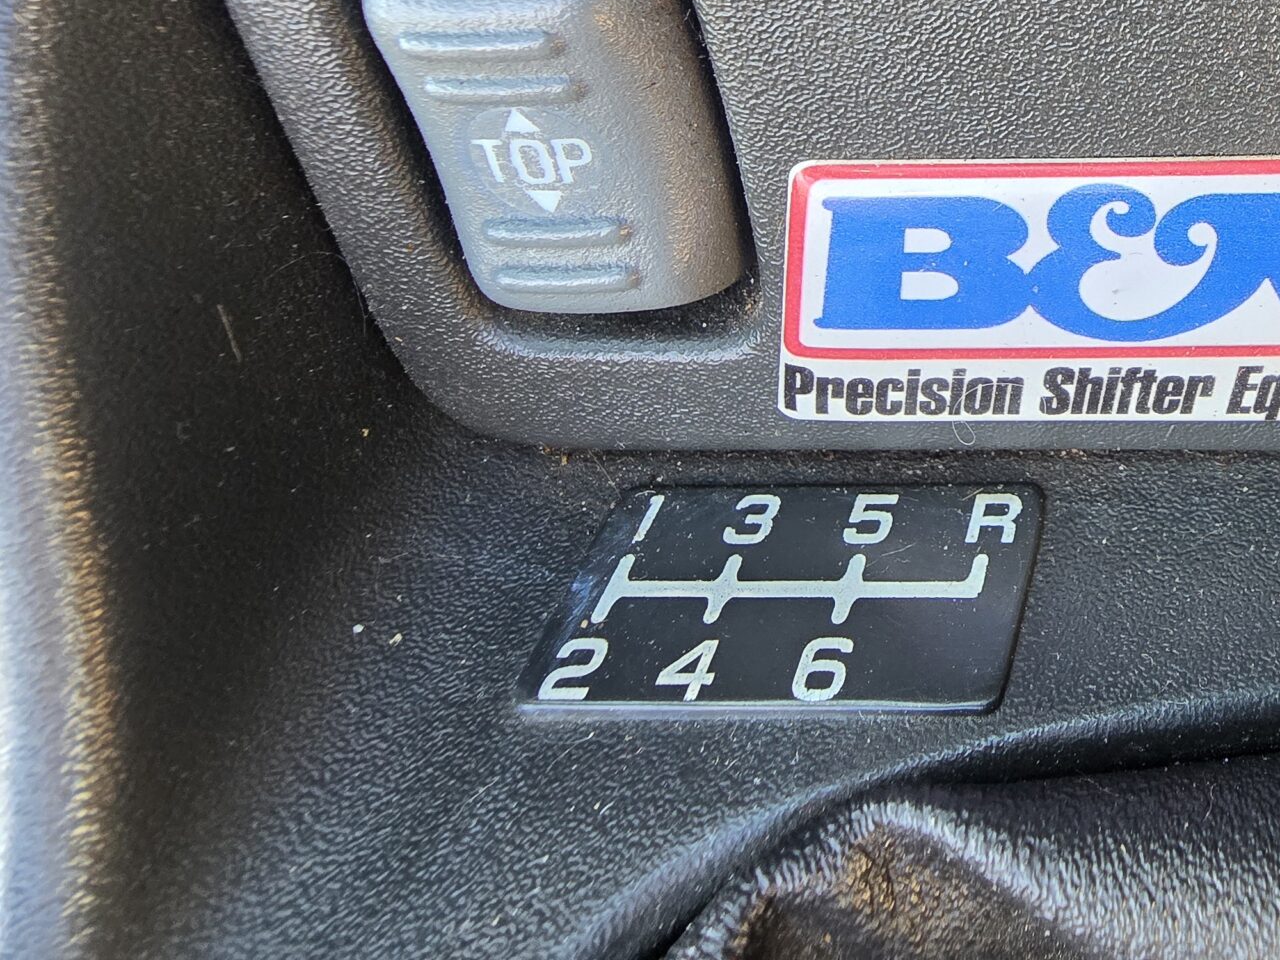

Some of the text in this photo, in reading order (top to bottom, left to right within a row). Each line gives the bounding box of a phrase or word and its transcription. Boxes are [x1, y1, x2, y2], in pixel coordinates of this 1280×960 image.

[471, 138, 592, 185] TOP
[782, 363, 1025, 416] Precision
[1039, 365, 1214, 416] Shifter
[632, 493, 1023, 544] 1 3 5 R
[537, 636, 854, 702] 2 4 6
